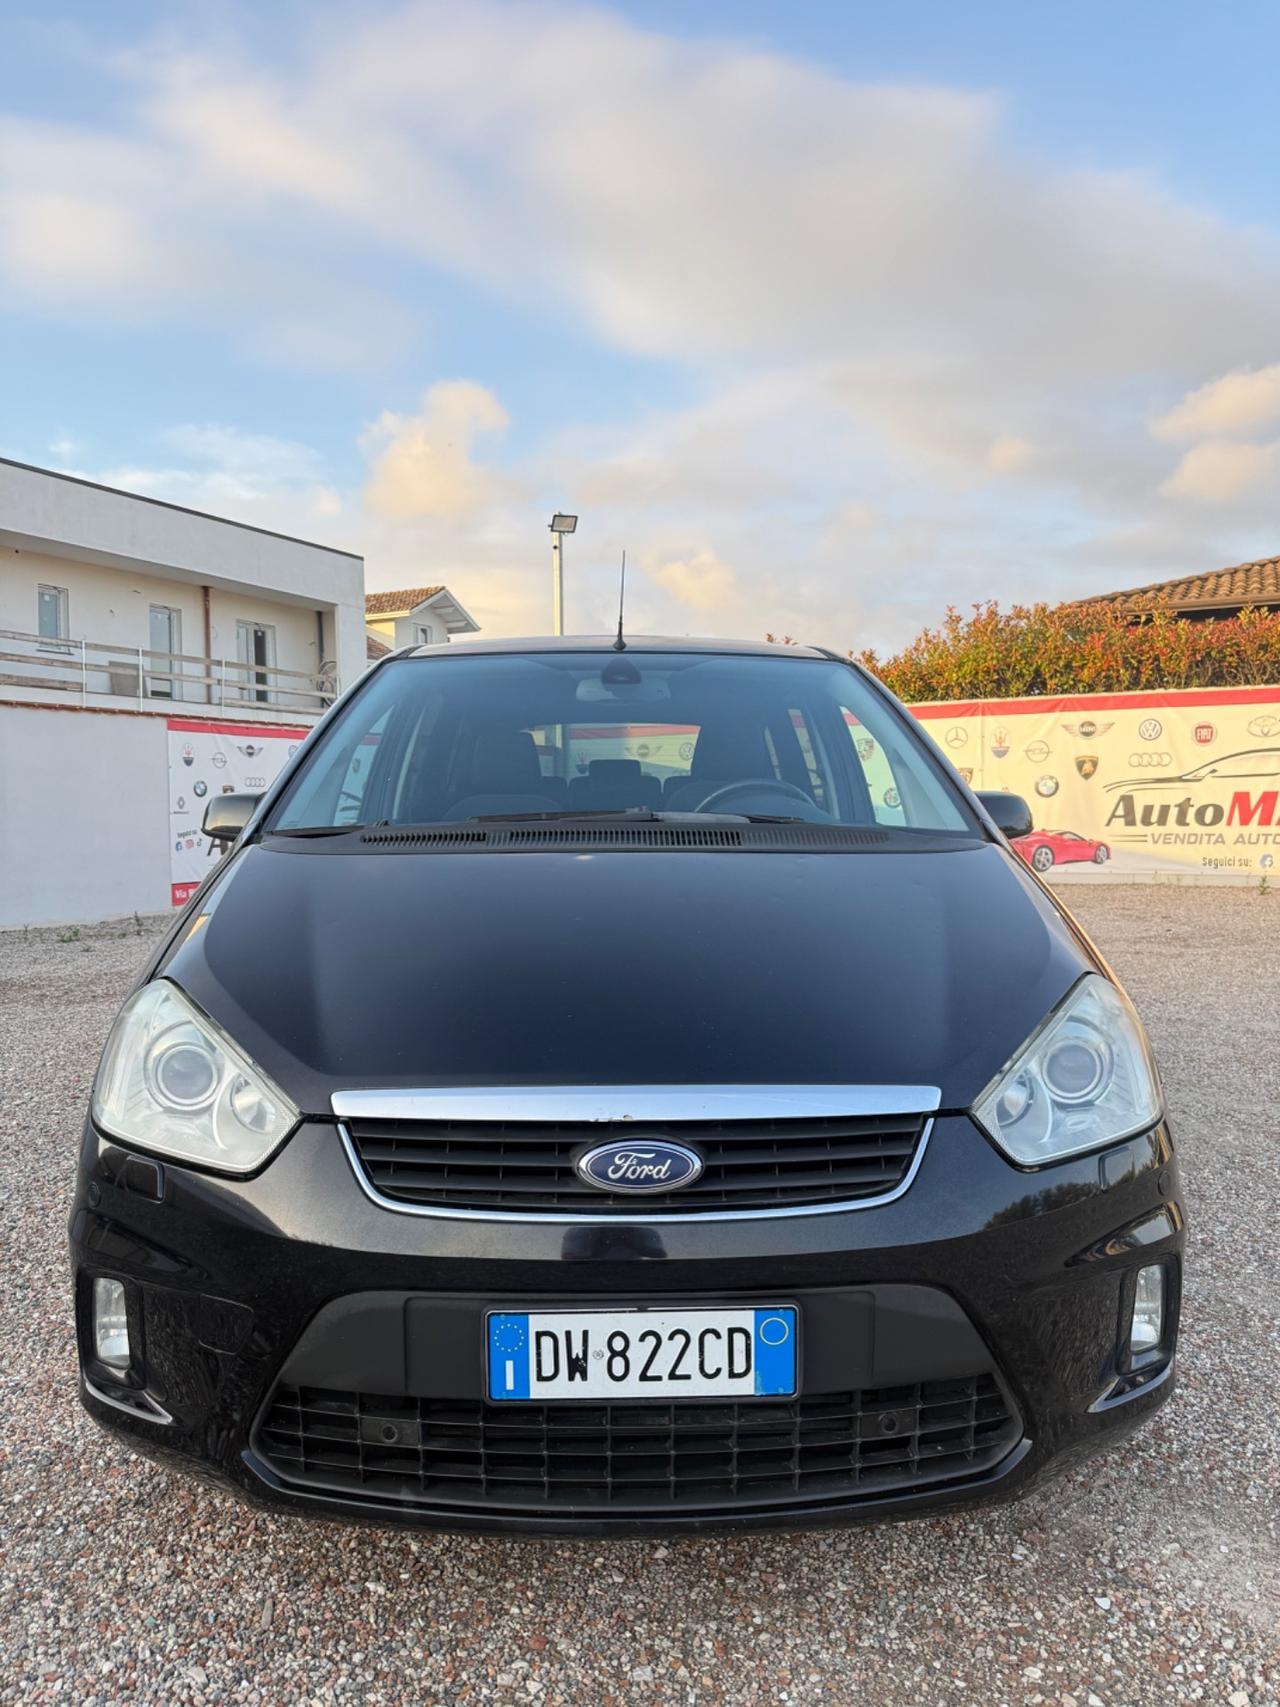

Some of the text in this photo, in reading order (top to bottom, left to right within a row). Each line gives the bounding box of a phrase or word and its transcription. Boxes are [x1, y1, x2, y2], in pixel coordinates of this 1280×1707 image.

[1196, 728, 1213, 740] FIAT
[1104, 791, 1280, 827] AutoM
[1150, 832, 1226, 846] VENDITA
[1202, 856, 1236, 869] Seguici
[608, 1151, 671, 1179] Ford
